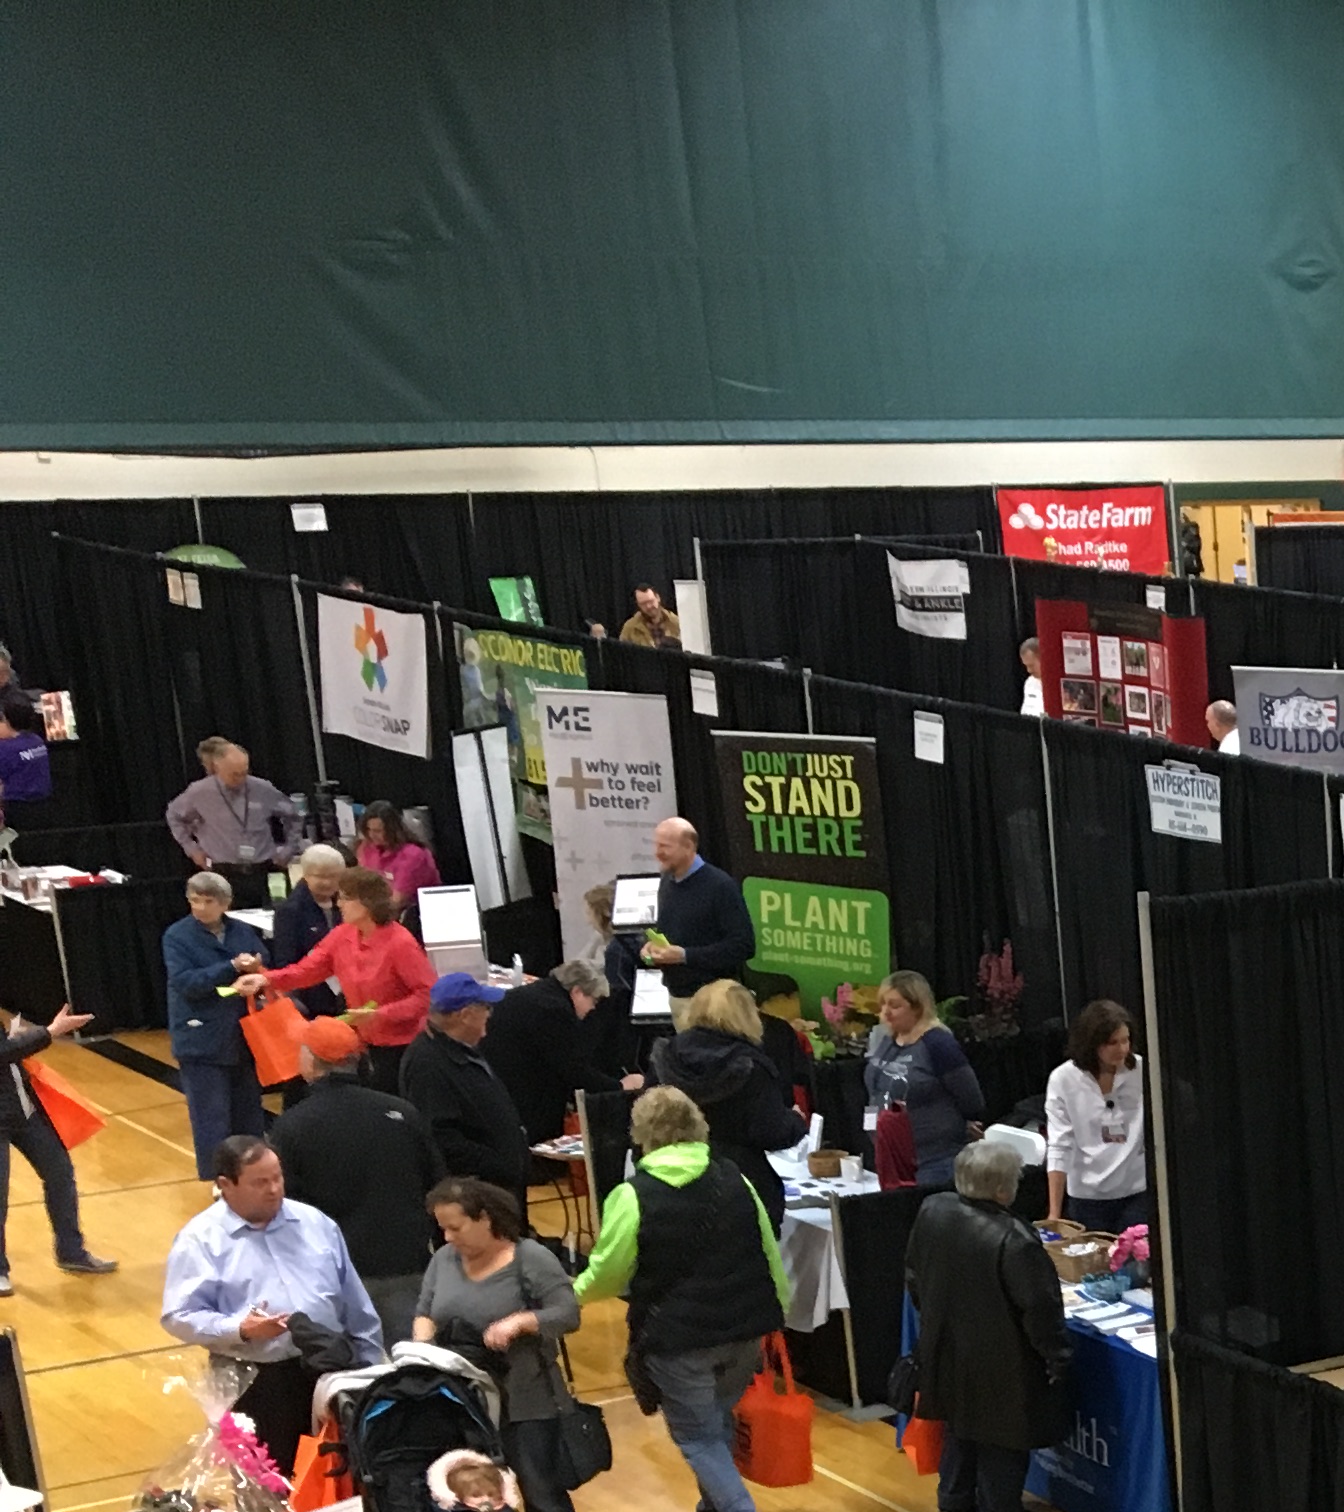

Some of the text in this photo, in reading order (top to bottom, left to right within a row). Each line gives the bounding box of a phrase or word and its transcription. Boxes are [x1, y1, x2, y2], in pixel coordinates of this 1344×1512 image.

[1045, 502, 1154, 530] StateFarm
[1054, 541, 1082, 556] had
[546, 704, 593, 732] ME
[585, 759, 662, 776] why wait
[741, 751, 855, 779] DON'T JUST
[607, 776, 662, 793] to feel
[743, 774, 862, 819] STAND
[1151, 770, 1220, 801] HYPERSTITCH
[588, 793, 650, 811] better?
[746, 814, 867, 858] THERE
[759, 890, 872, 936] PLANT
[761, 927, 872, 958] SOMETHING
[761, 951, 872, 975] plant-something.org
